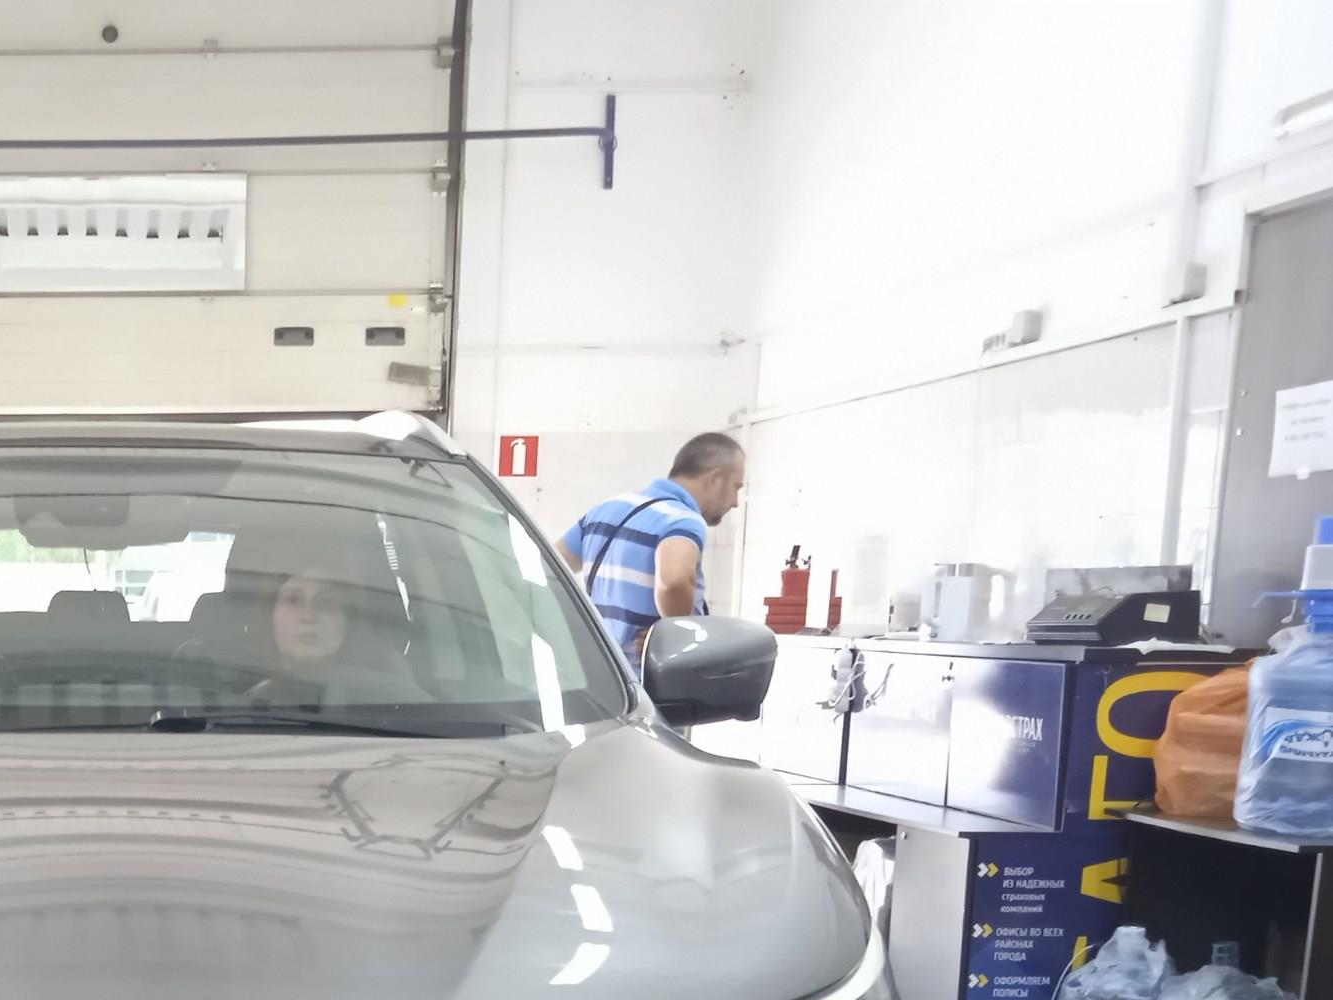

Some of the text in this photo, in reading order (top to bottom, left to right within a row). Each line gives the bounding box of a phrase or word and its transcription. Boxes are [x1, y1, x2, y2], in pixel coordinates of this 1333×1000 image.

[1003, 866, 1034, 877] ВЫБОР
[1002, 879, 1065, 889] ИЗ НАДЕЖНЫХ
[995, 927, 1064, 938] ОФИСЫ ВО ВСЕХ
[994, 939, 1034, 949] РАЙОНАХ
[993, 951, 1027, 961] ГОРОДА
[993, 976, 1051, 986] ОФОРМЛЯЕМ
[992, 988, 1028, 998] ПОЛИСЫ
